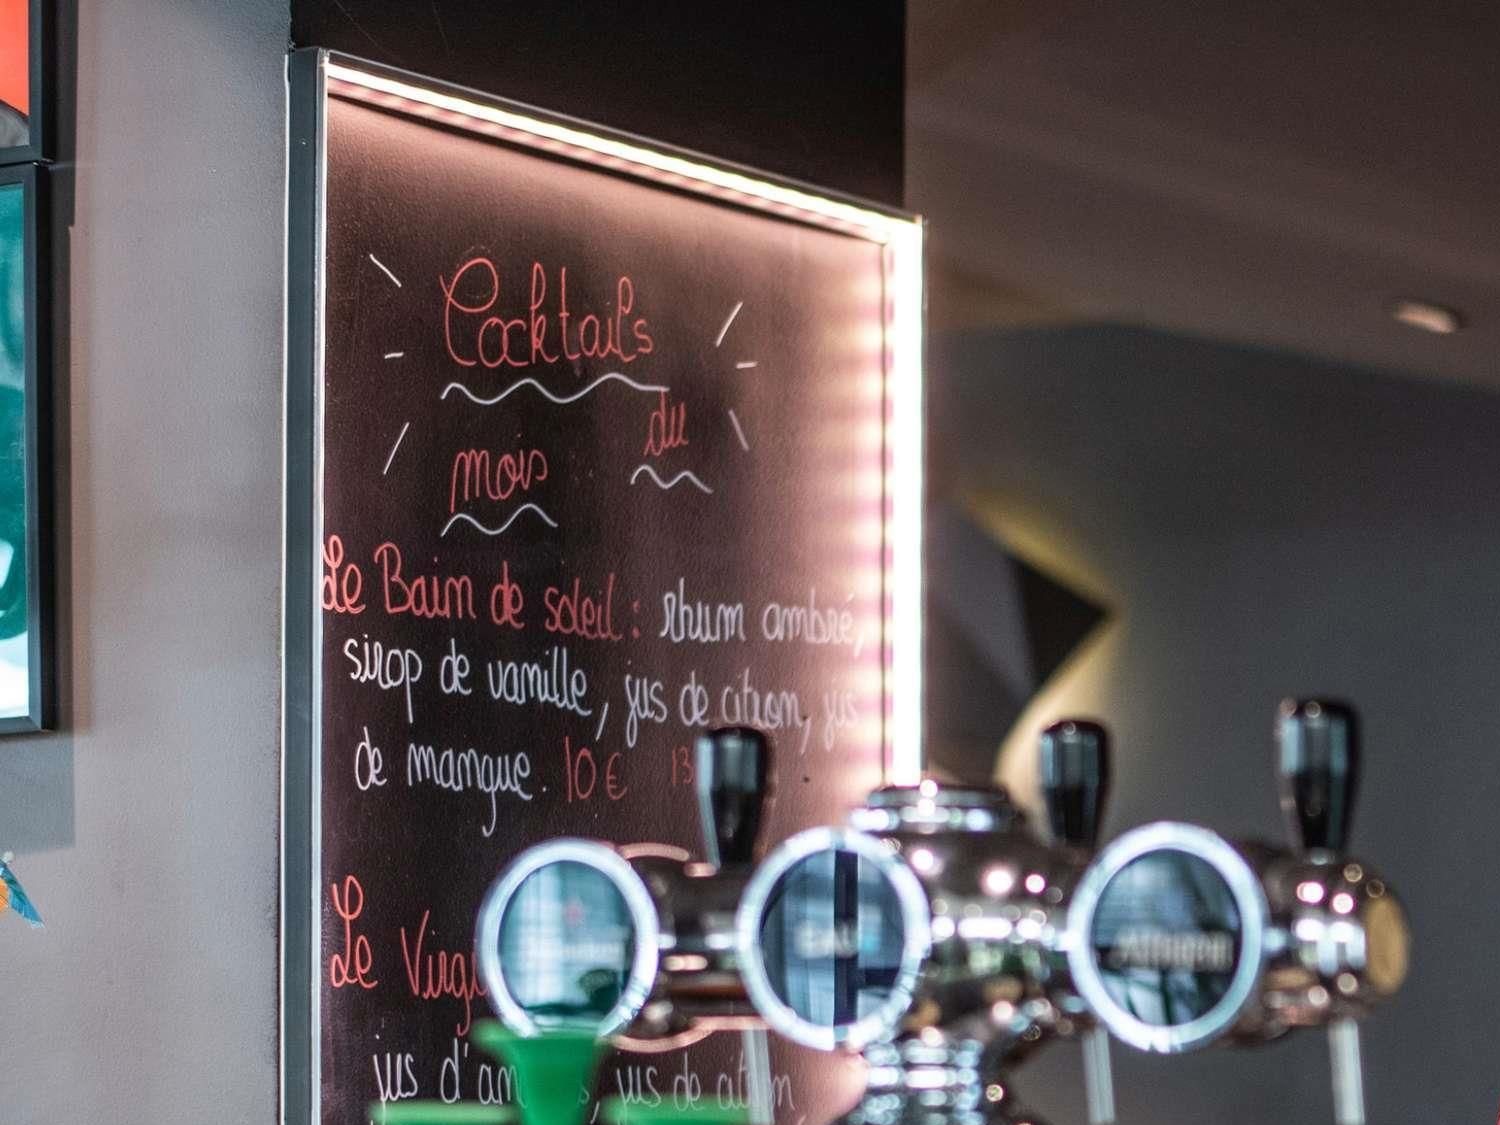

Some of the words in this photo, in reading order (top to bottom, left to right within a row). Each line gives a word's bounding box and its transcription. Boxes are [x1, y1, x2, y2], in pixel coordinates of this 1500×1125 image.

[439, 257, 654, 368] Cocktails
[643, 387, 689, 456] du
[450, 433, 549, 513] mois
[321, 534, 366, 614] Le
[374, 542, 476, 619] Bain
[491, 560, 534, 629] de
[659, 577, 746, 643] rhum
[343, 634, 422, 724] sirop
[440, 637, 472, 696] de
[488, 645, 609, 741] vanille,
[624, 660, 668, 749] jus
[679, 671, 710, 727] de
[720, 667, 811, 754] citron,
[823, 678, 860, 752] jus
[354, 726, 387, 791] de
[330, 875, 379, 989] Le
[400, 910, 491, 1037] Virgi
[673, 1051, 705, 1112] de
